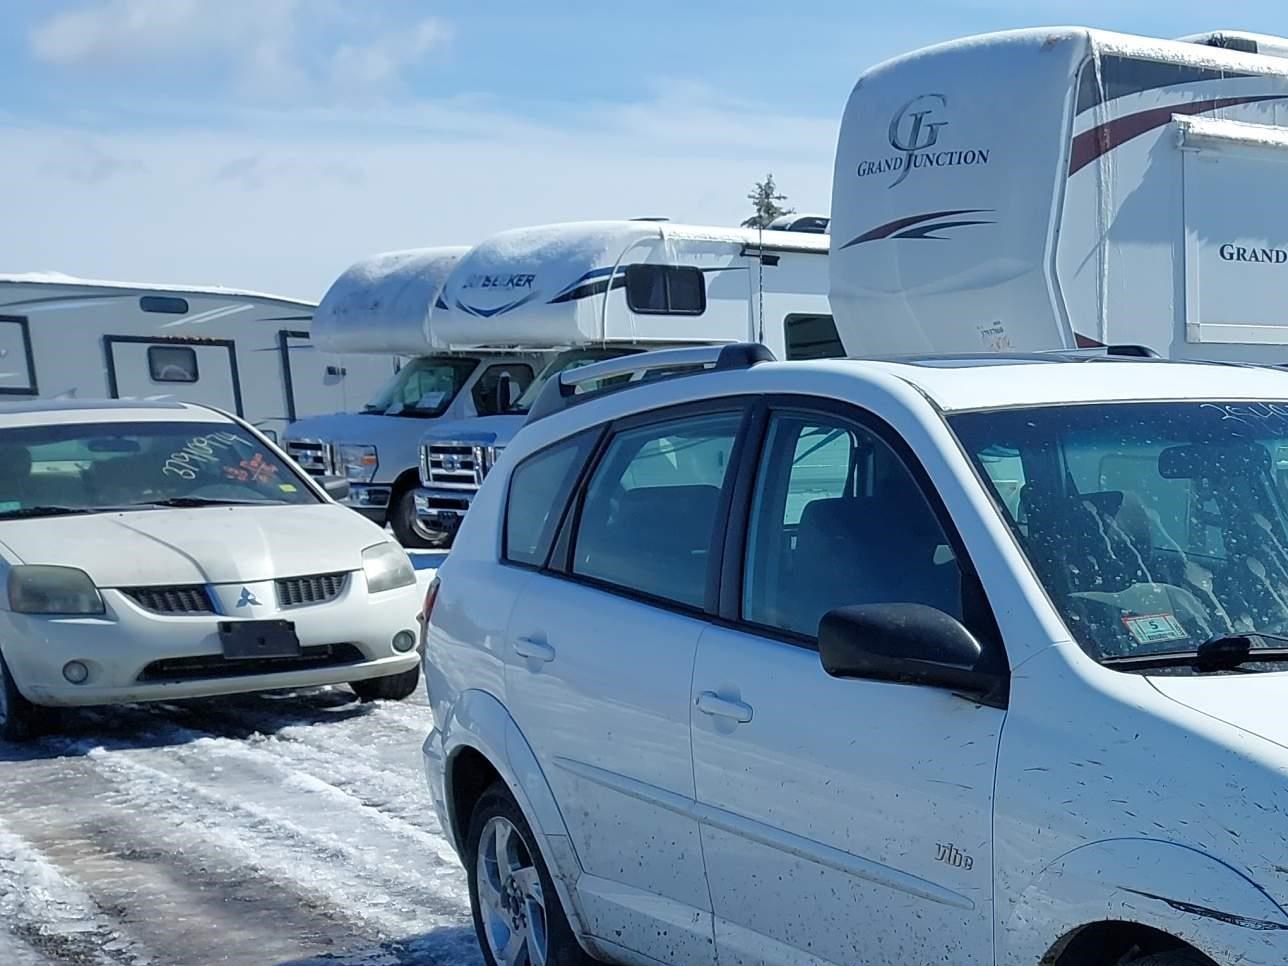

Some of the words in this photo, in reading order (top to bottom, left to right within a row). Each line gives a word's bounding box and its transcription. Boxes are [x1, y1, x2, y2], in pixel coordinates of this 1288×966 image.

[857, 156, 903, 177] GRAND
[904, 149, 990, 172] JUNCTION
[1219, 243, 1288, 264] GRAND
[934, 842, 974, 871] vibe
